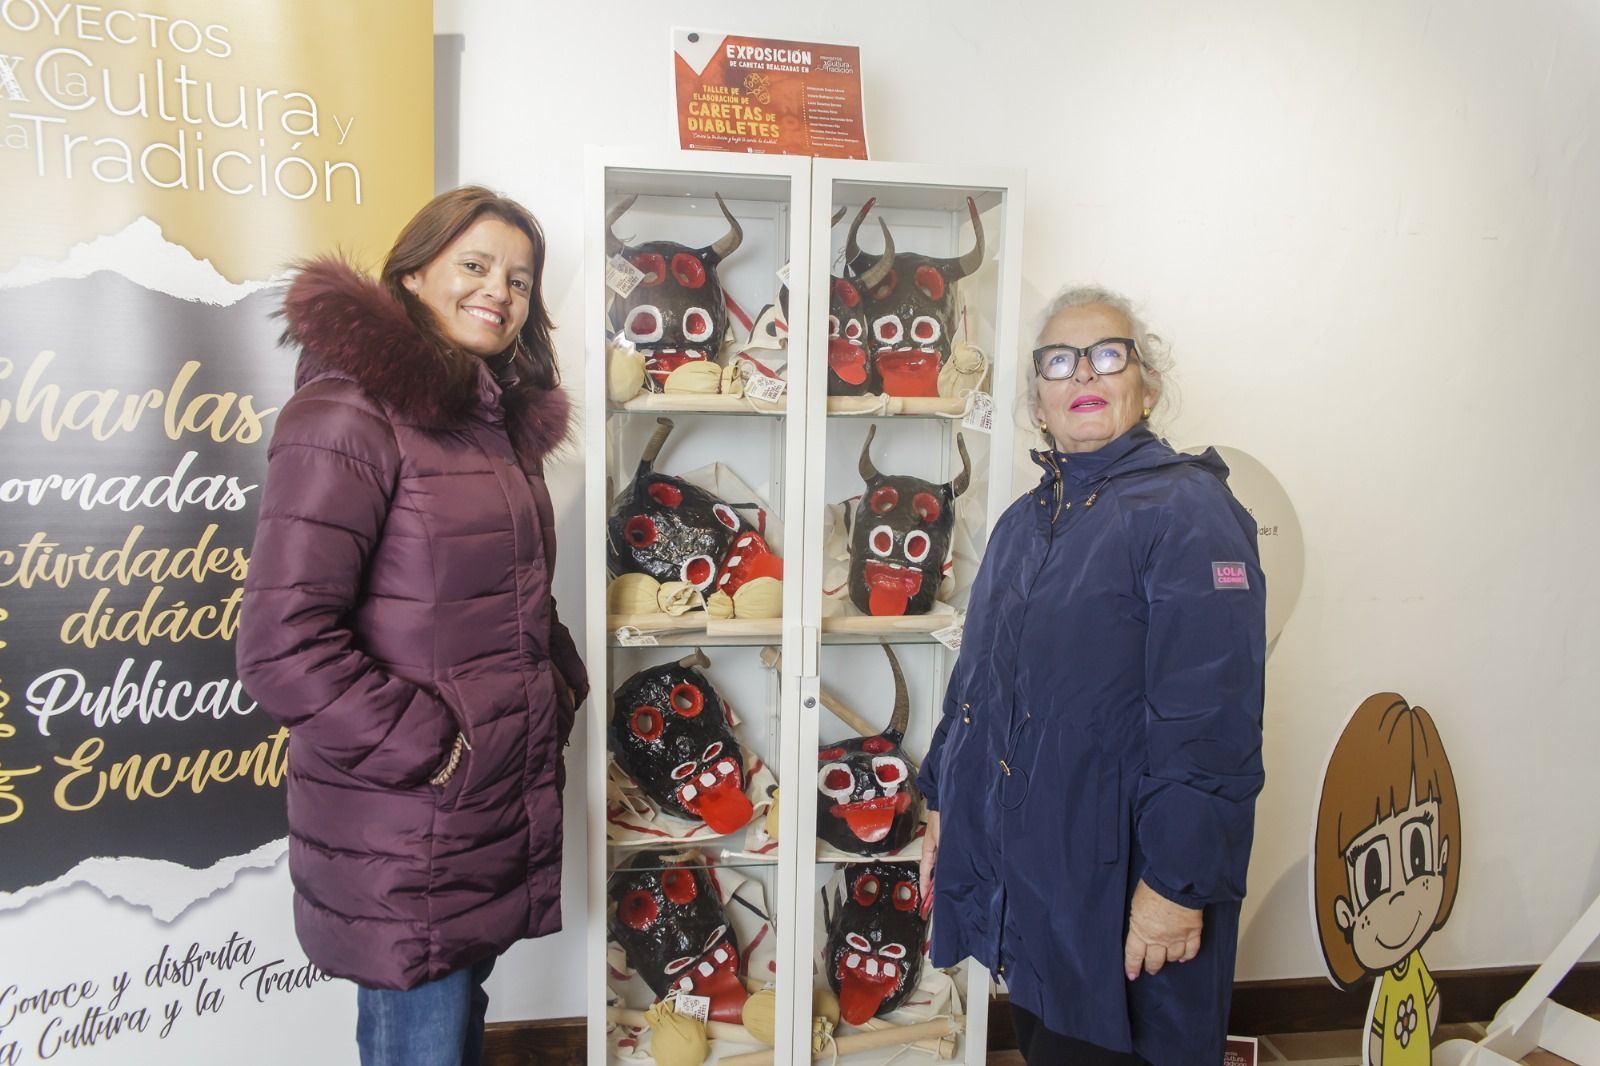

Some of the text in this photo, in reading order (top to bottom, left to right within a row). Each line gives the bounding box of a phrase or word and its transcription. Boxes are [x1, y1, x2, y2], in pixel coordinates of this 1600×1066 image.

[2, 0, 233, 58] OYECTOS
[726, 44, 811, 65] EXPOSICIÓN
[702, 85, 740, 95] TALLER DE
[739, 61, 764, 70] CARETAS
[766, 63, 800, 72] REALIZADAS
[35, 48, 320, 137] Cultura
[333, 114, 355, 145] y
[688, 101, 776, 122] CARETAS DE
[693, 93, 750, 105] ELABORACIÓN DE
[688, 117, 780, 138] DIABLETES
[0, 113, 361, 205] a Tradición
[0, 451, 258, 512] ornadas
[0, 523, 250, 588] ctividades
[1216, 566, 1244, 577] LOLA
[26, 658, 258, 736] Publicac
[0, 931, 256, 1028] Conoce y disfruta
[0, 958, 334, 1066] a Cultura y la Tradic
